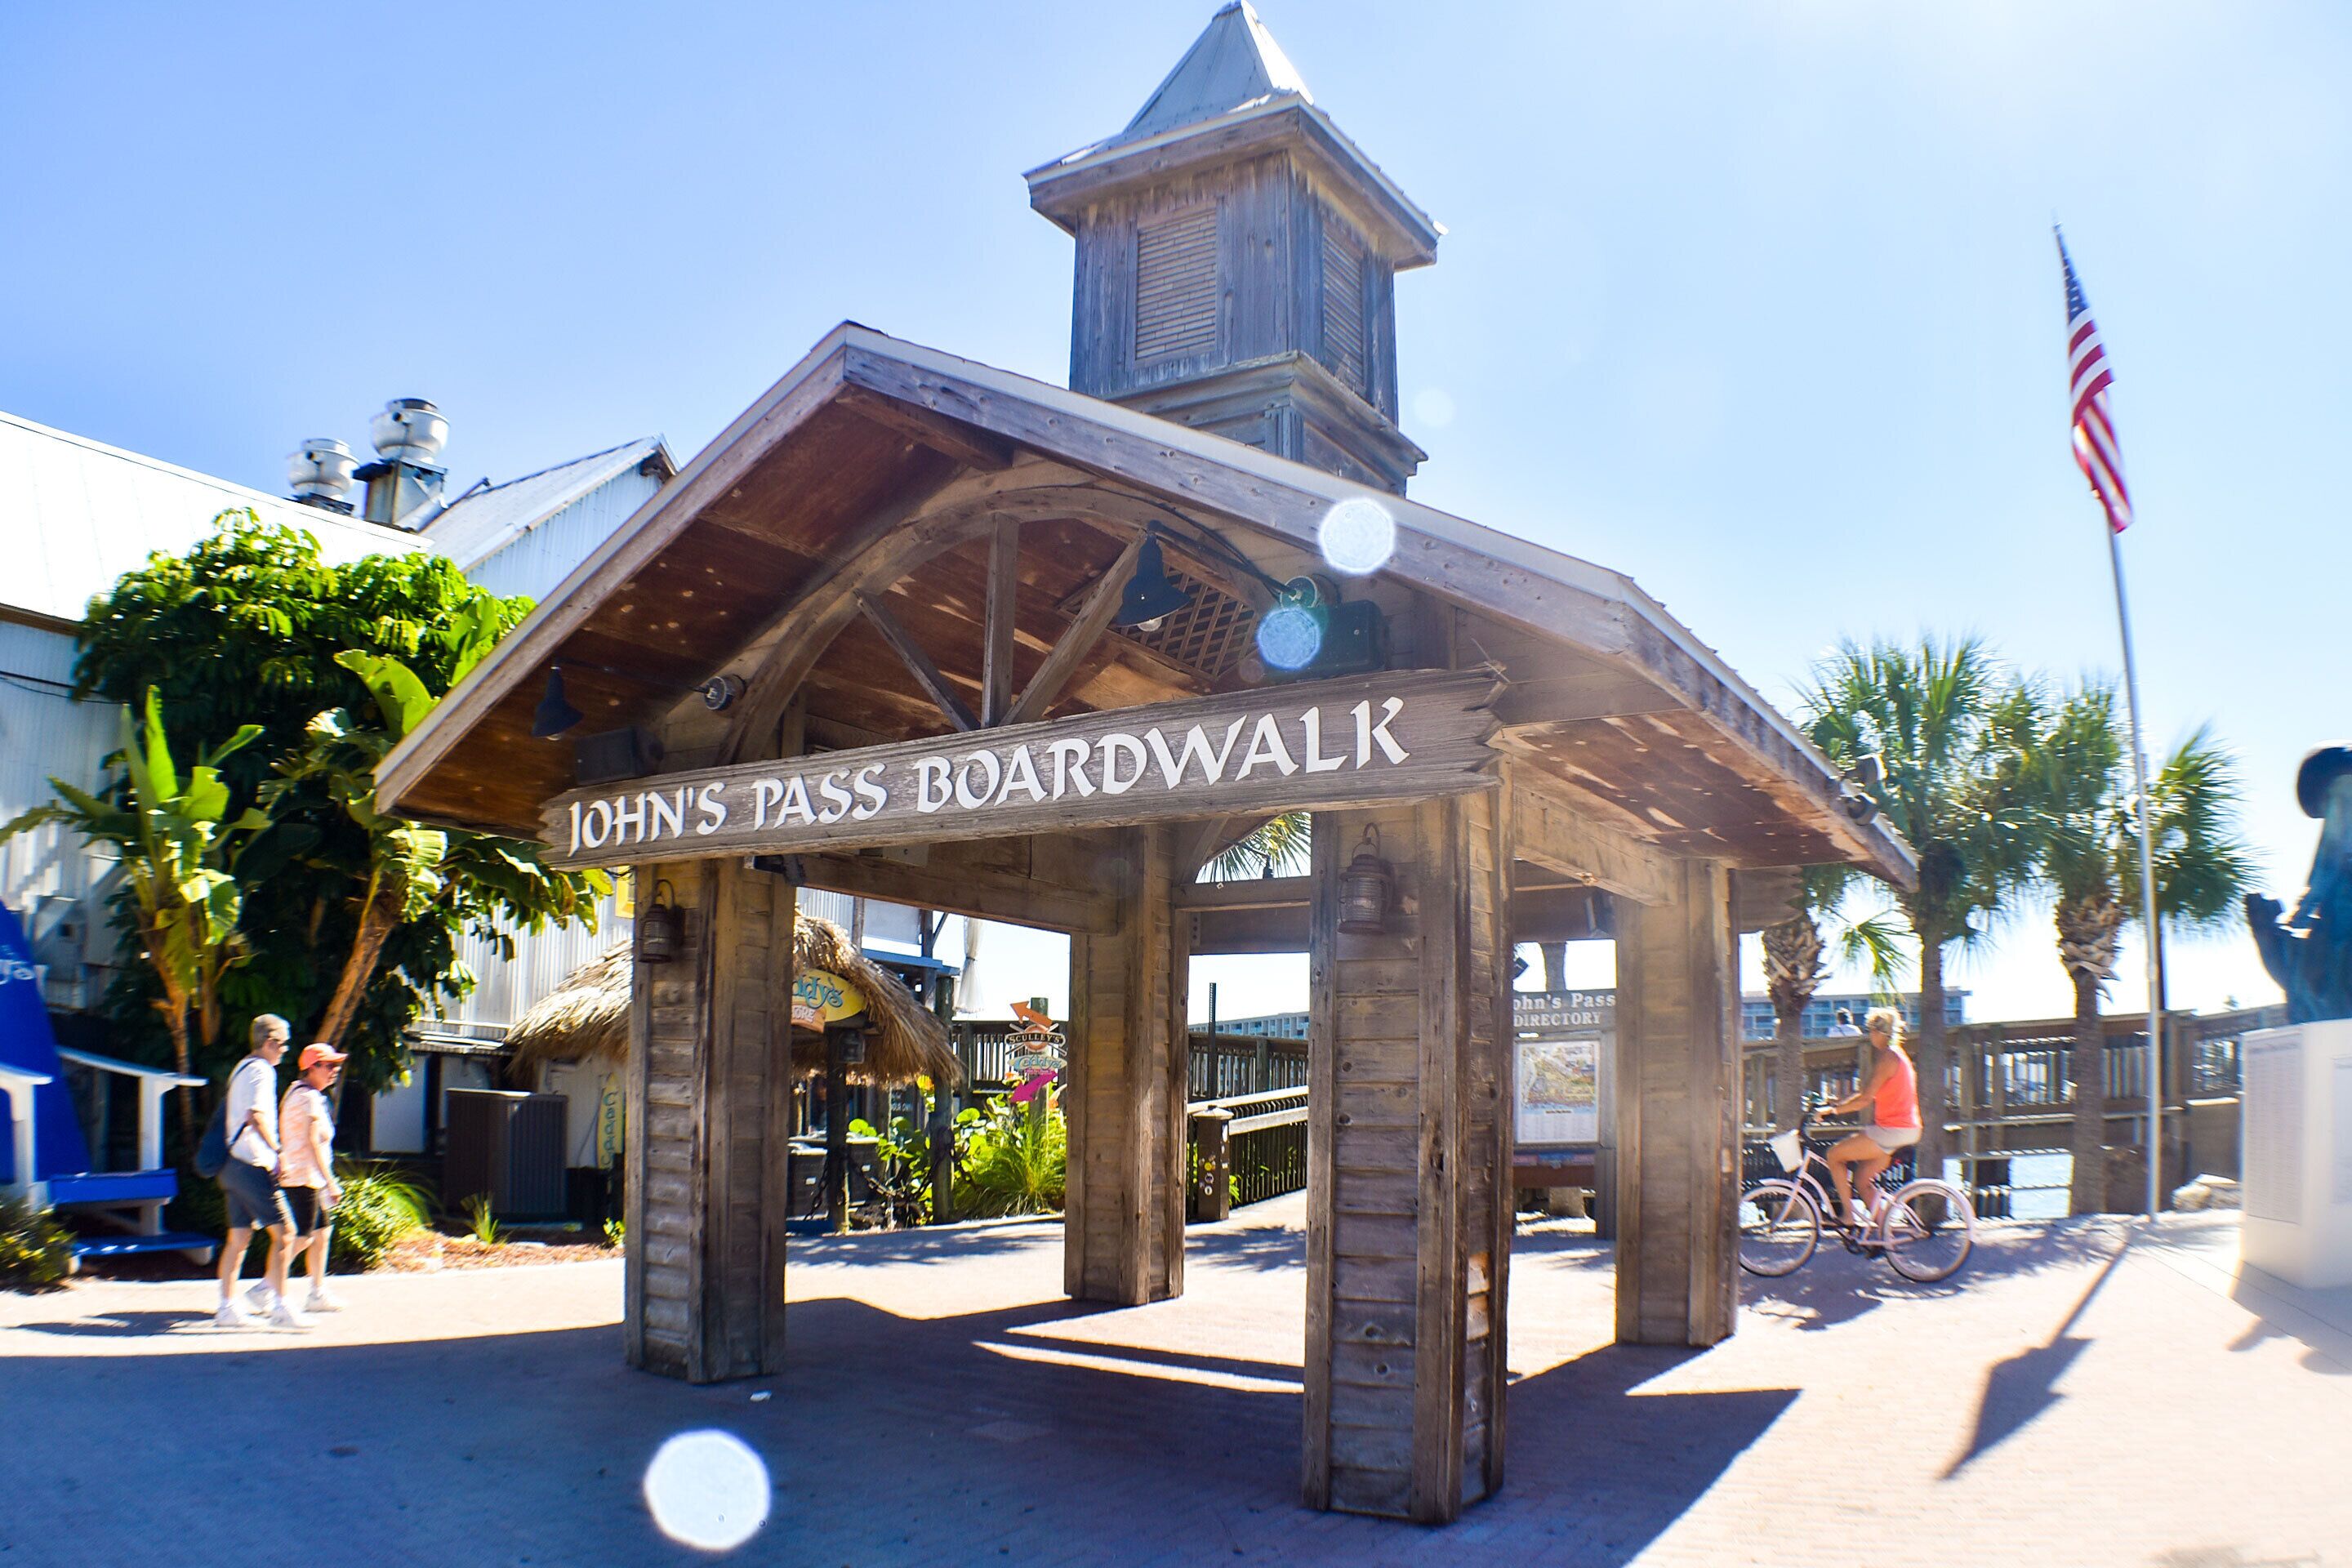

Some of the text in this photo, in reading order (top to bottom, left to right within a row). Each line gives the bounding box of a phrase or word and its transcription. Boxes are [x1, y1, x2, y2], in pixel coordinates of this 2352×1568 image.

[568, 696, 1410, 857] JOHN'S PASS BOARDWALK
[792, 974, 844, 1008] ddy's
[1513, 992, 1616, 1011] ohn's Pass
[794, 1006, 815, 1024] ORE
[1513, 1011, 1601, 1027] DIRECTORY
[1009, 1032, 1061, 1044] SCULLEY'S
